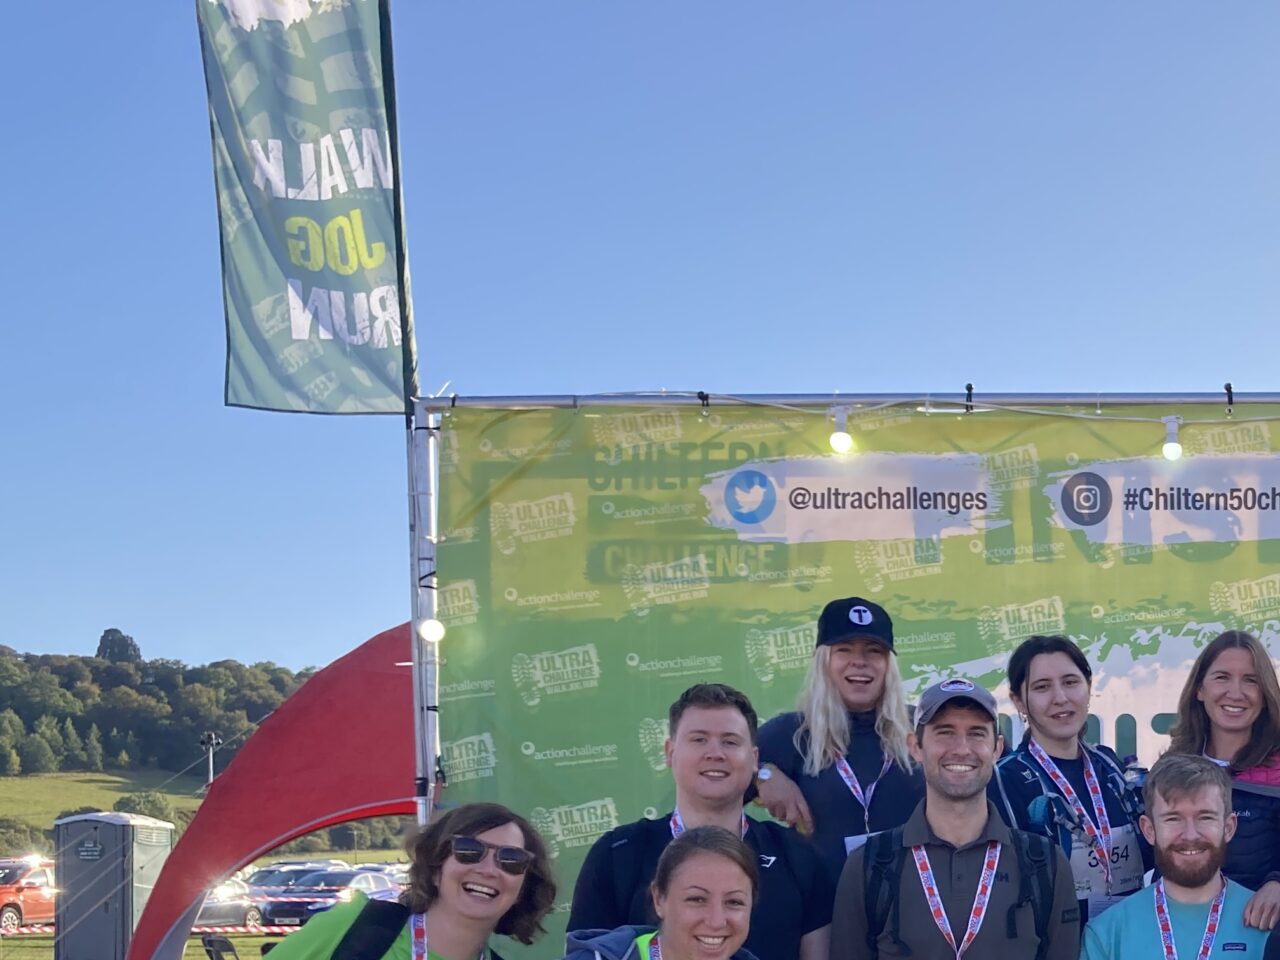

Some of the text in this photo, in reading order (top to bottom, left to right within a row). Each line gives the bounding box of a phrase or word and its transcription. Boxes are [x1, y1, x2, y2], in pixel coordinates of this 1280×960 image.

[788, 486, 989, 516] @ultrachallenges
[441, 586, 473, 606] TRA
[773, 627, 817, 648] ULTR
[1088, 844, 1130, 868] 354
